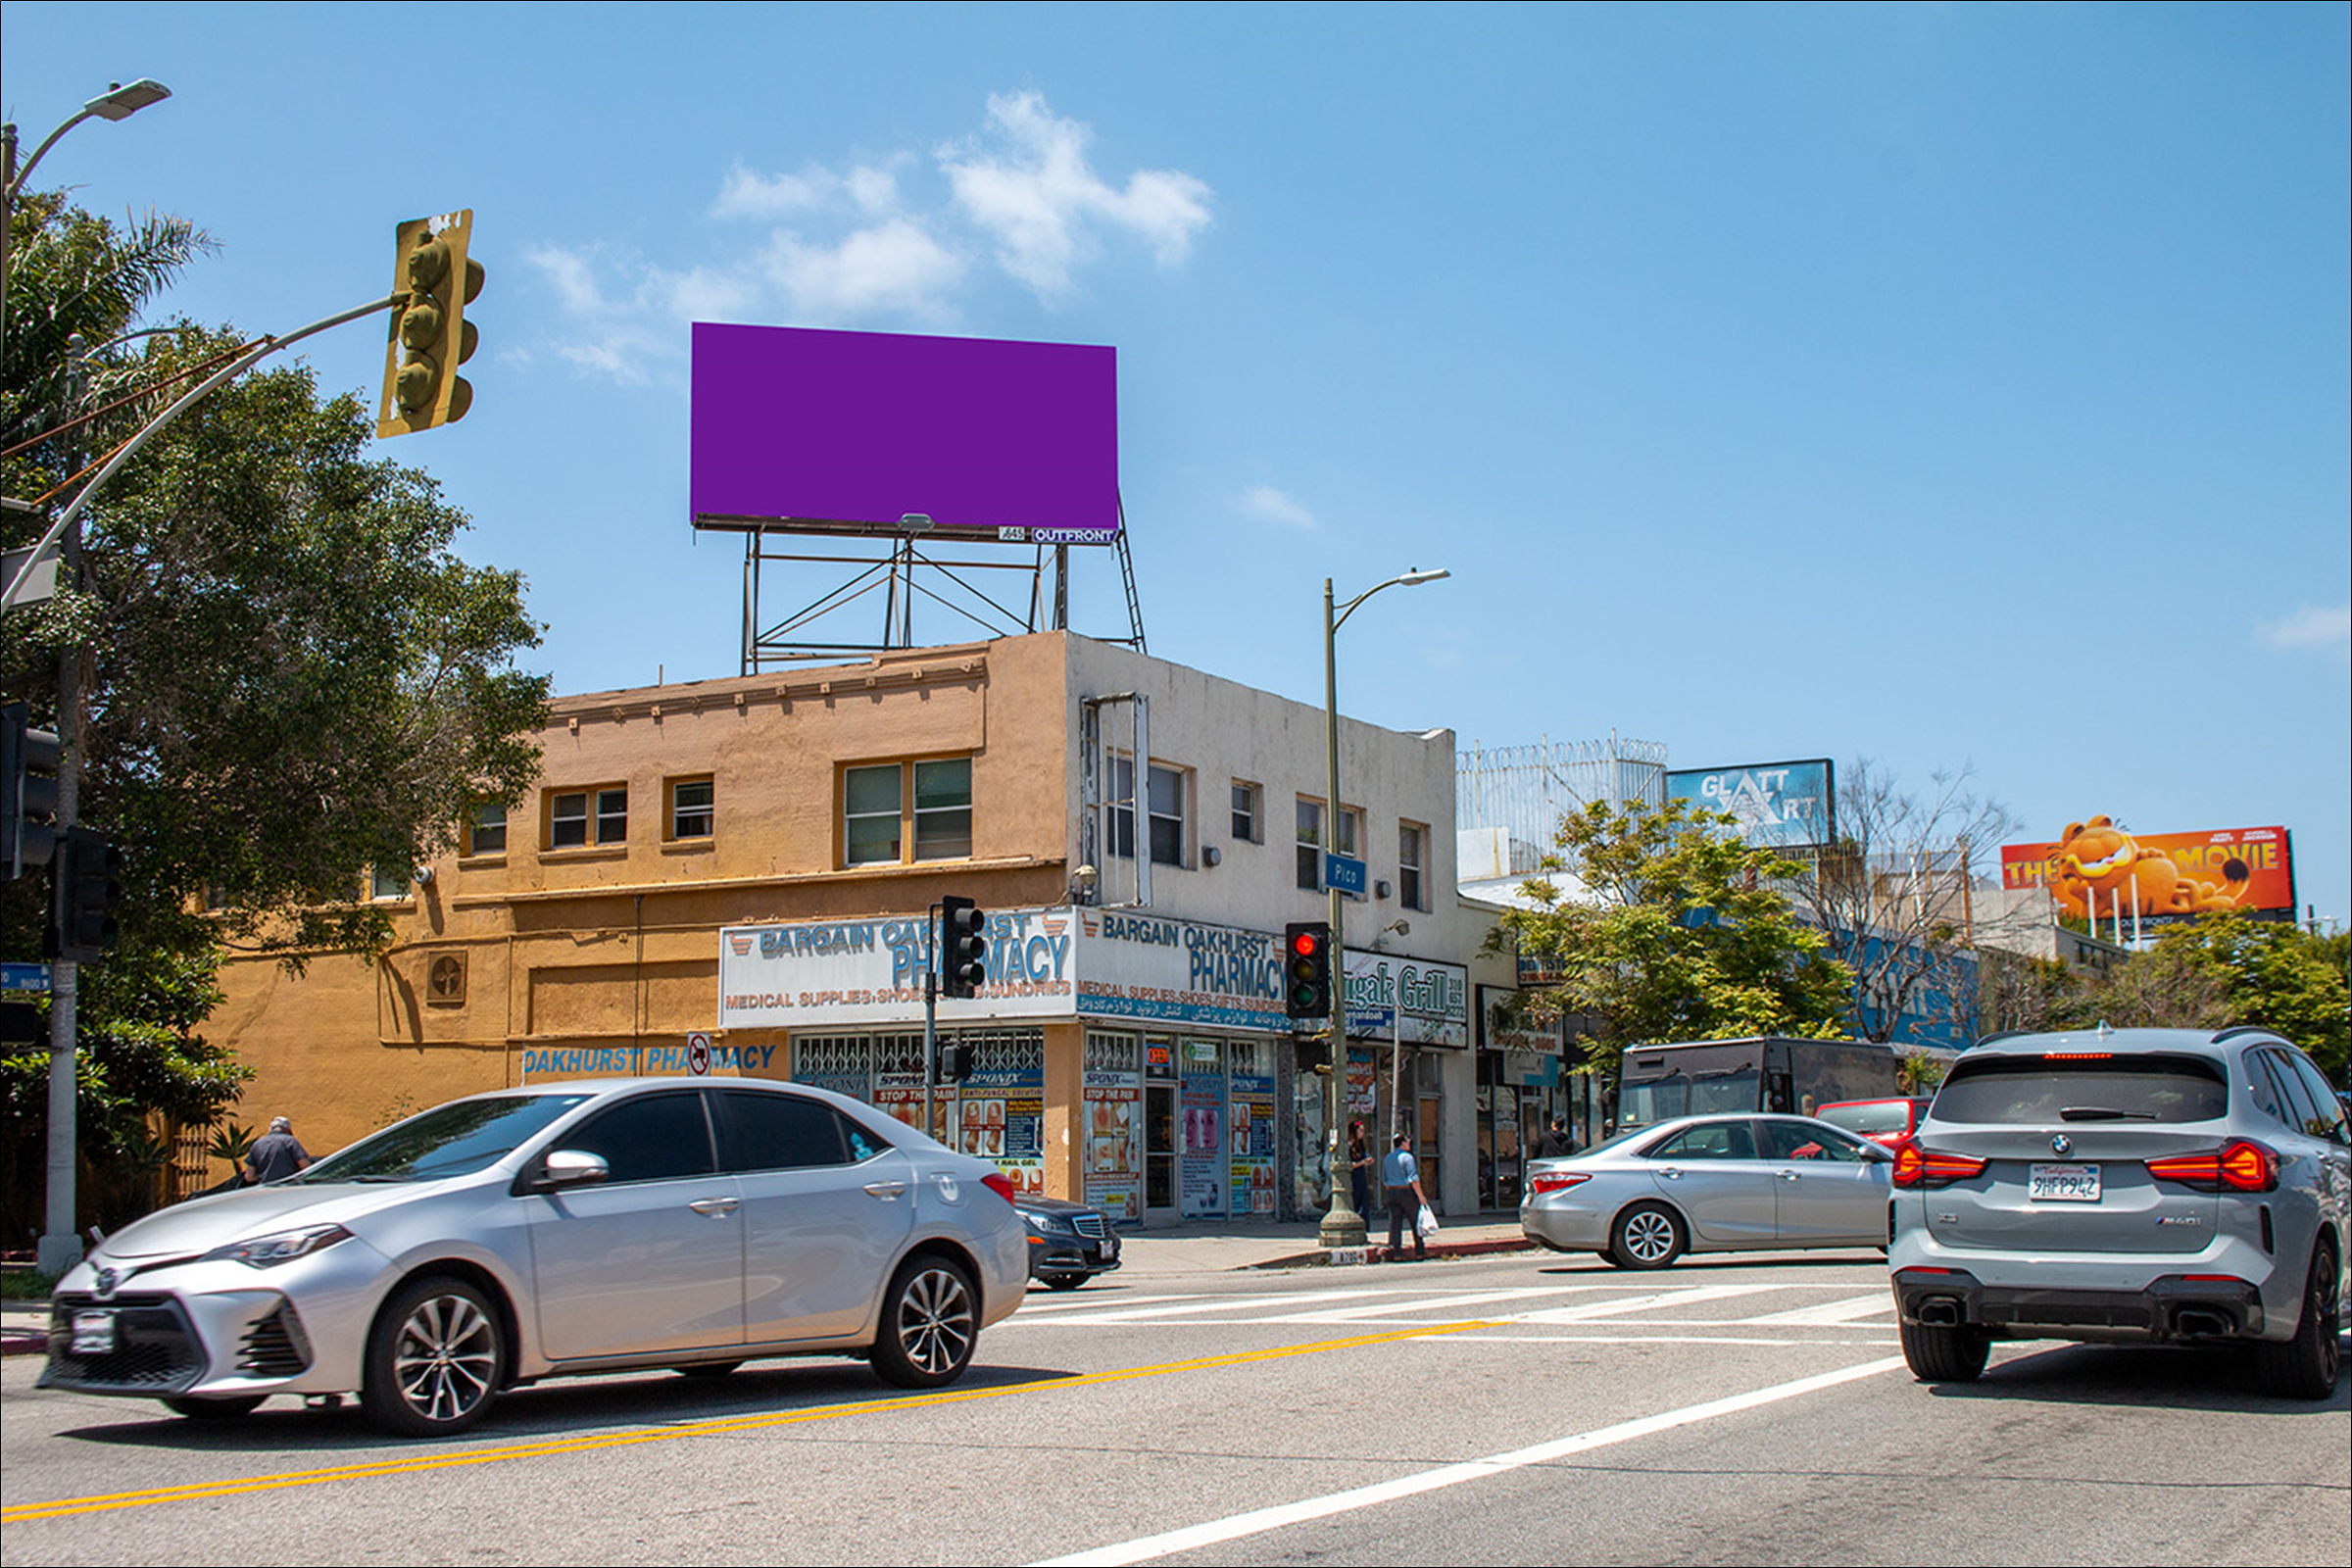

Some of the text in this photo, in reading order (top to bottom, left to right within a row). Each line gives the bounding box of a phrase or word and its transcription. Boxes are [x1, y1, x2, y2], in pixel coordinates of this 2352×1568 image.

[1034, 528, 1114, 542] OUTFRONT
[1701, 770, 1789, 811] GLATT
[1335, 863, 1357, 884] Pico
[2005, 843, 2279, 886] THE MOVIE
[760, 913, 1031, 956] BARGAIN OAKRST
[1102, 915, 1270, 960] BARGAIN OAKHURST
[892, 934, 1070, 989] PHMACY
[725, 993, 795, 1010] MEDICAL
[799, 988, 871, 1007] SUPPLIES
[989, 979, 1072, 1000] SUNDRIES
[1078, 980, 1125, 998] MEDICAL
[1128, 985, 1175, 1003] SUPPLIES
[1179, 990, 1211, 1006] SHOES
[1345, 964, 1393, 1008] ngak
[1398, 965, 1447, 1012] Grill
[524, 1045, 776, 1072] OAKHURST PHAMACY
[1148, 1048, 1169, 1063] OPEN
[967, 1072, 1022, 1085] SPONIX
[1086, 1073, 1122, 1084] SPONIX
[880, 1091, 906, 1102] STOP
[934, 1089, 956, 1100] PAIN
[1086, 1090, 1104, 1100] STOP
[2034, 1177, 2095, 1195] 9HFP942
